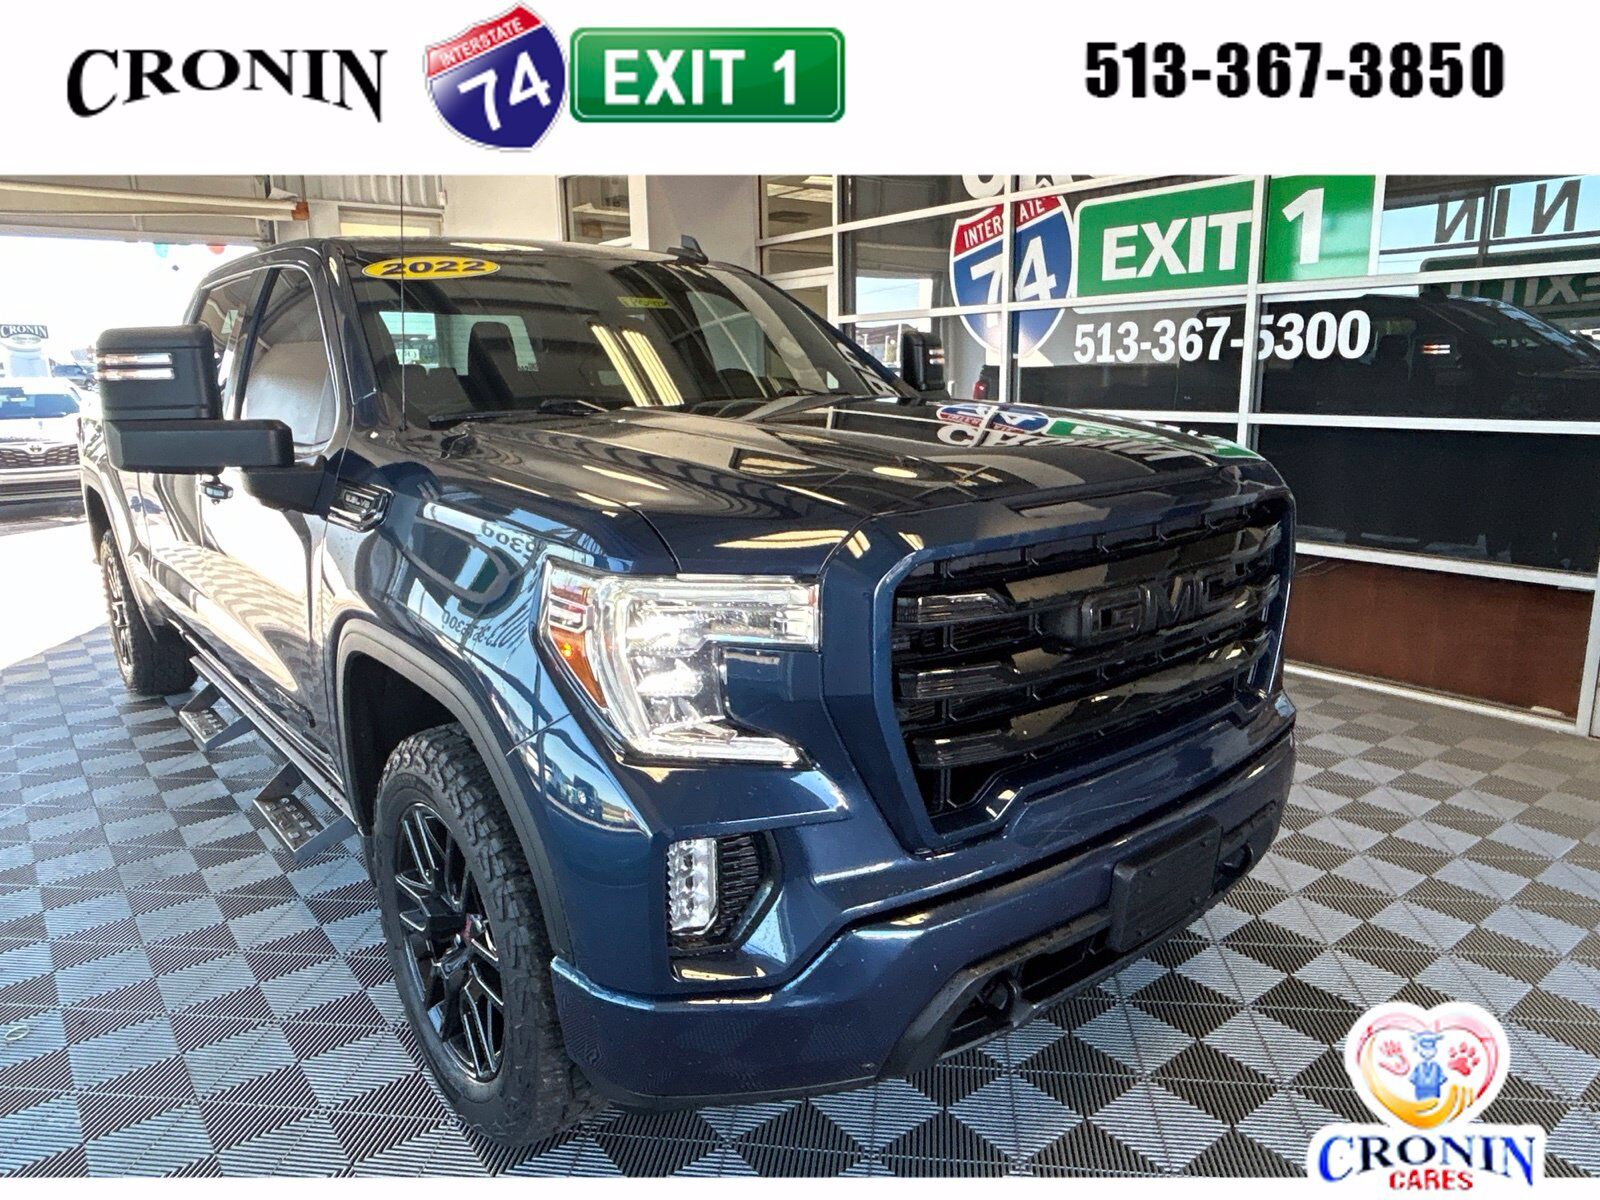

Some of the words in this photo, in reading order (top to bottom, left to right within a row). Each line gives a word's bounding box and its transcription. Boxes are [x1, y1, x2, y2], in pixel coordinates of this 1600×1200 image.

[1101, 209, 1253, 281] EXIT
[1281, 187, 1325, 265] 1
[380, 260, 487, 276] 2022
[970, 236, 1058, 329] 74
[0, 324, 48, 338] CRONIN
[1073, 309, 1371, 364] 513-367-5300
[1080, 566, 1230, 641] GMC
